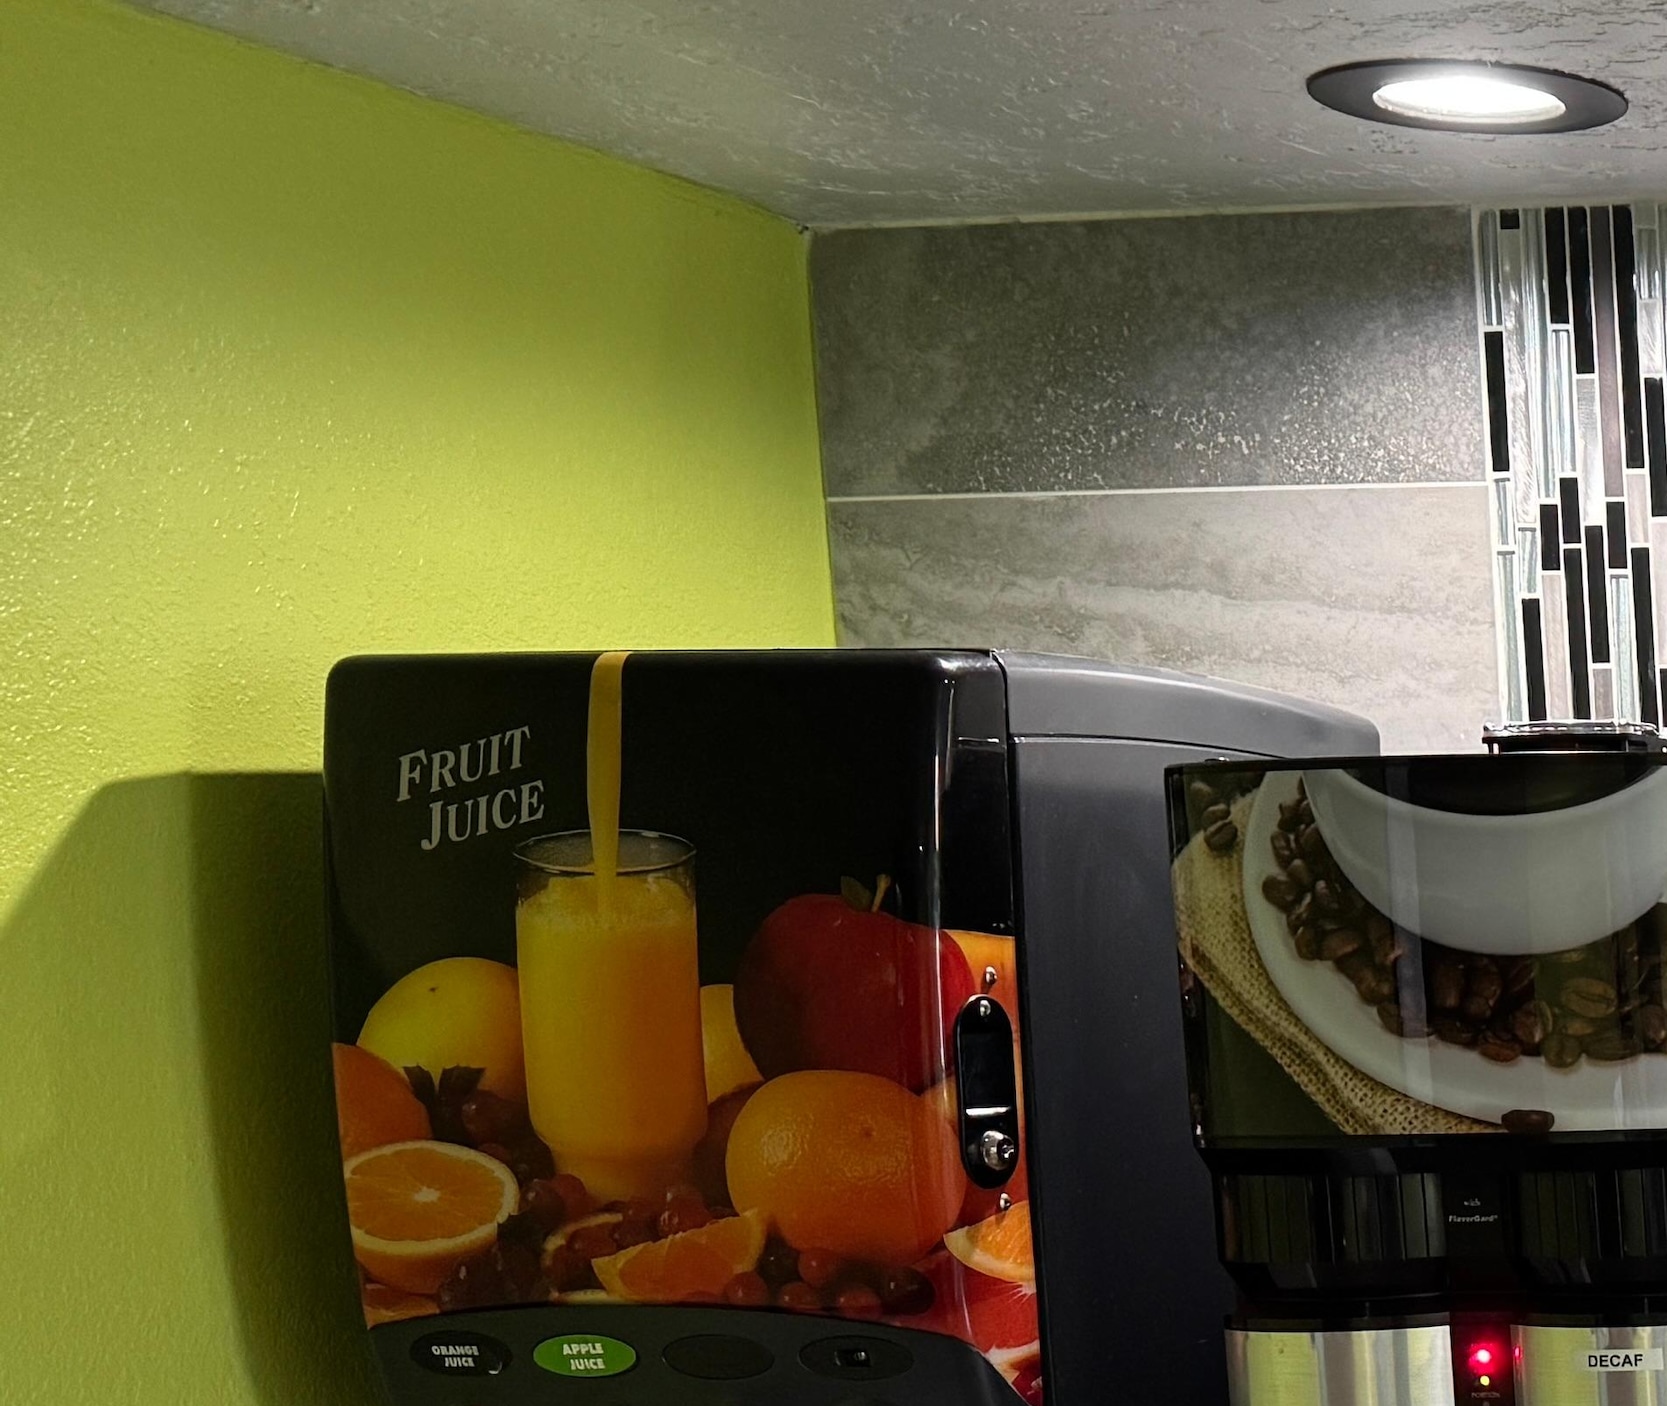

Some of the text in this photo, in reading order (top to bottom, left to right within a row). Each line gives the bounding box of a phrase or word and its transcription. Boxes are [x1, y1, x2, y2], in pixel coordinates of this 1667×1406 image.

[397, 726, 531, 802] FRUIT
[420, 780, 545, 850] JUICE
[431, 1345, 480, 1357] ORANGE
[562, 1343, 604, 1355] APPLE
[444, 1355, 475, 1368] JUICE
[570, 1358, 605, 1370] JUICE
[1588, 1354, 1643, 1368] DECAF
